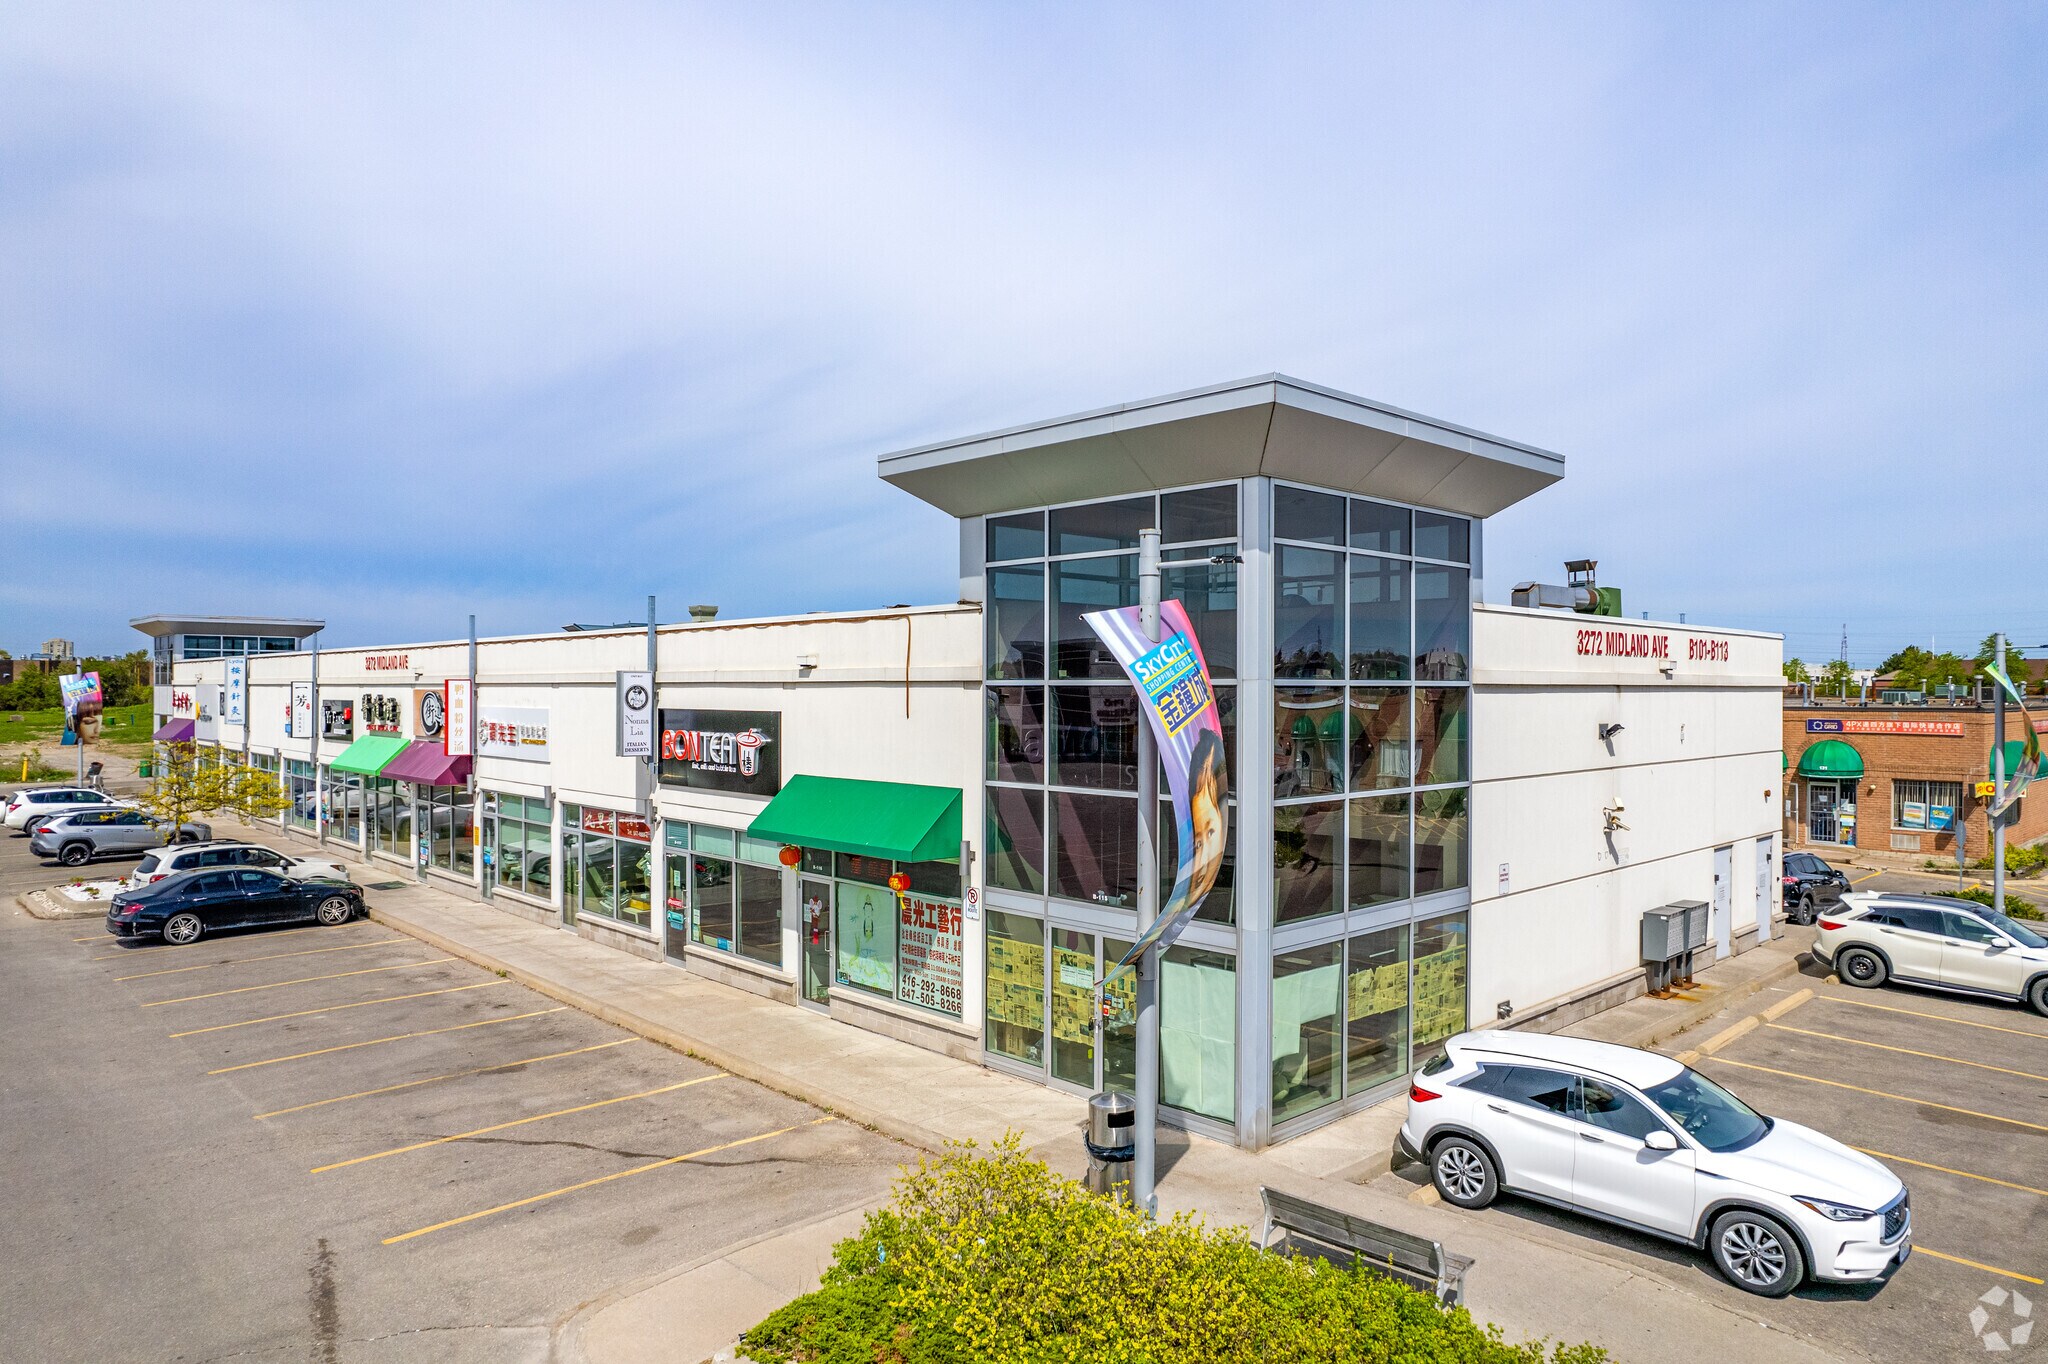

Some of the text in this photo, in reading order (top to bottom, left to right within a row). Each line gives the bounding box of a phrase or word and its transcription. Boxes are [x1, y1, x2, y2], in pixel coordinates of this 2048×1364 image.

[1577, 629, 1728, 662] 3272 MIDLAND AVE B101-B113
[366, 654, 408, 670] 3272 MIDLAND AVE
[1146, 668, 1175, 692] SHOPPING
[295, 686, 308, 707] 一芳
[1157, 668, 1210, 725] 金鐘城
[625, 715, 649, 724] Nonna
[630, 727, 644, 735] Lia
[902, 974, 962, 1000] 416-292-8668
[902, 987, 962, 1013] 647-505-8266
